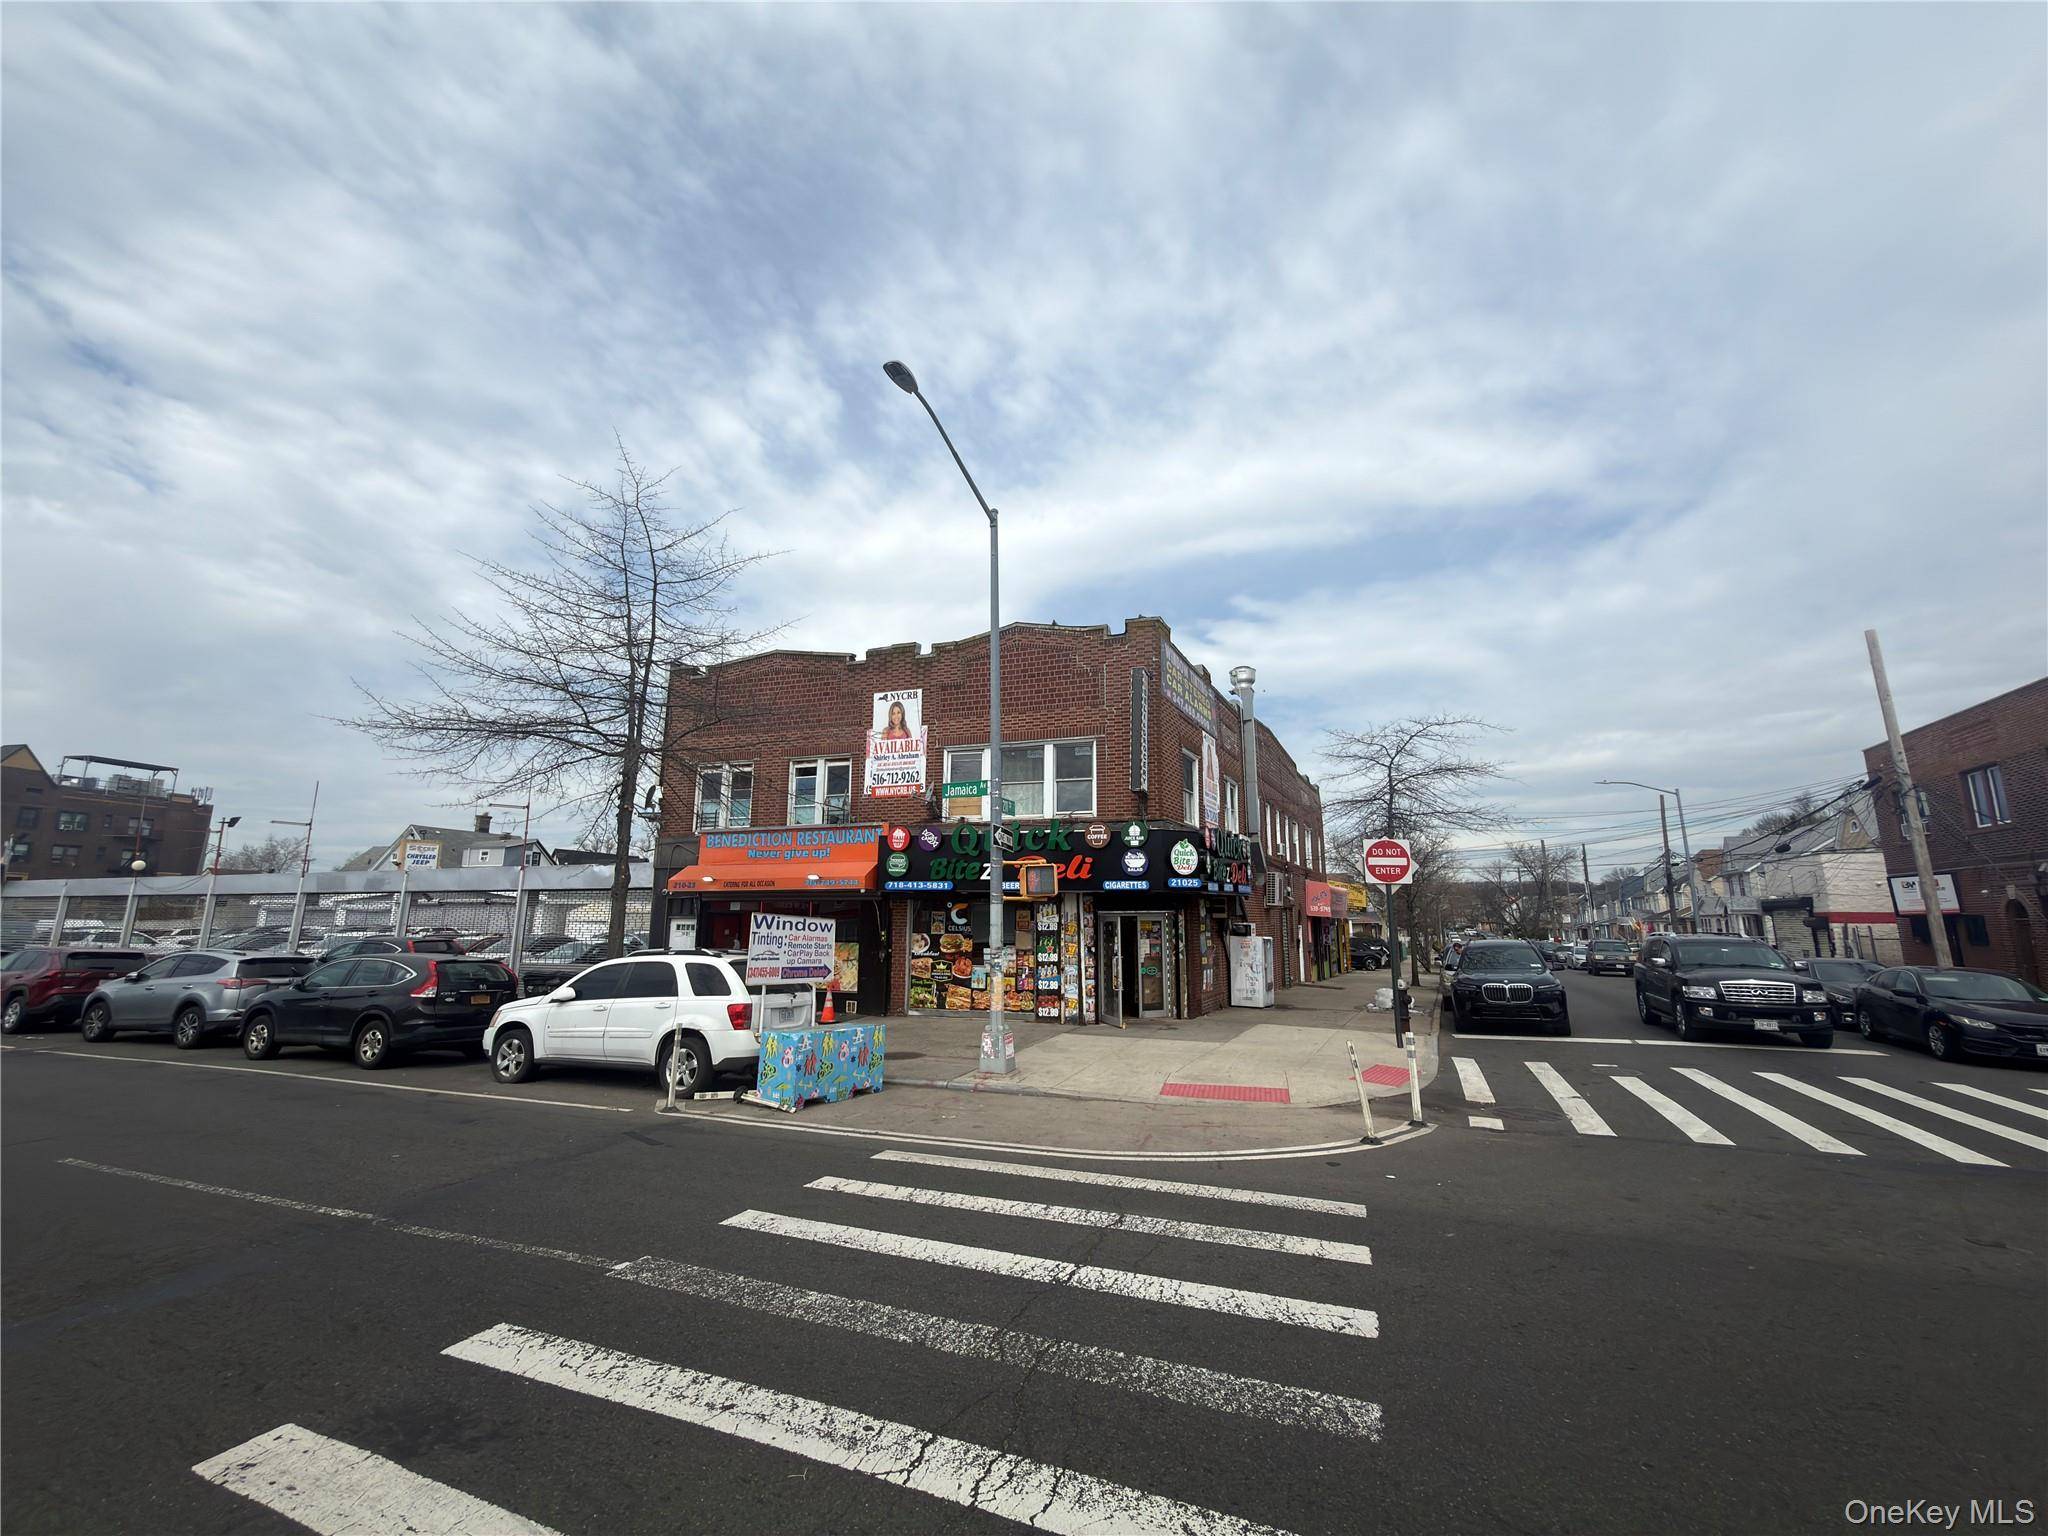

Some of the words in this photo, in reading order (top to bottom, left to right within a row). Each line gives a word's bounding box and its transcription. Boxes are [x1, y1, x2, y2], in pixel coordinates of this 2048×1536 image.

[1166, 661, 1182, 684] CAR
[1166, 674, 1182, 696] CAR
[890, 691, 918, 701] NYCRB
[873, 740, 920, 755] AVAILABLE
[897, 752, 920, 760] Abraham
[872, 771, 920, 786] 516-712-9262
[945, 784, 978, 797] Jamaica
[706, 831, 792, 848] BENEDICTION
[797, 828, 884, 846] RESTAURANT
[747, 849, 781, 859] Never
[784, 848, 809, 860] give
[812, 847, 830, 859] up!
[1174, 848, 1195, 858] Quick
[1372, 848, 1383, 856] DO
[1385, 848, 1401, 856] NOT
[1375, 867, 1401, 875] ENTER
[1104, 881, 1147, 889] CIGARETTES
[1171, 878, 1198, 887] 21025
[753, 914, 833, 933] Window
[1037, 922, 1058, 931] $12.99
[751, 931, 784, 949] Tinting
[814, 942, 833, 950] Starts
[787, 949, 813, 958] CarPlay
[1037, 952, 1058, 962] $12.99
[786, 958, 796, 966] up
[1038, 980, 1059, 990] $12.99
[1038, 1007, 1059, 1017] $12.99
